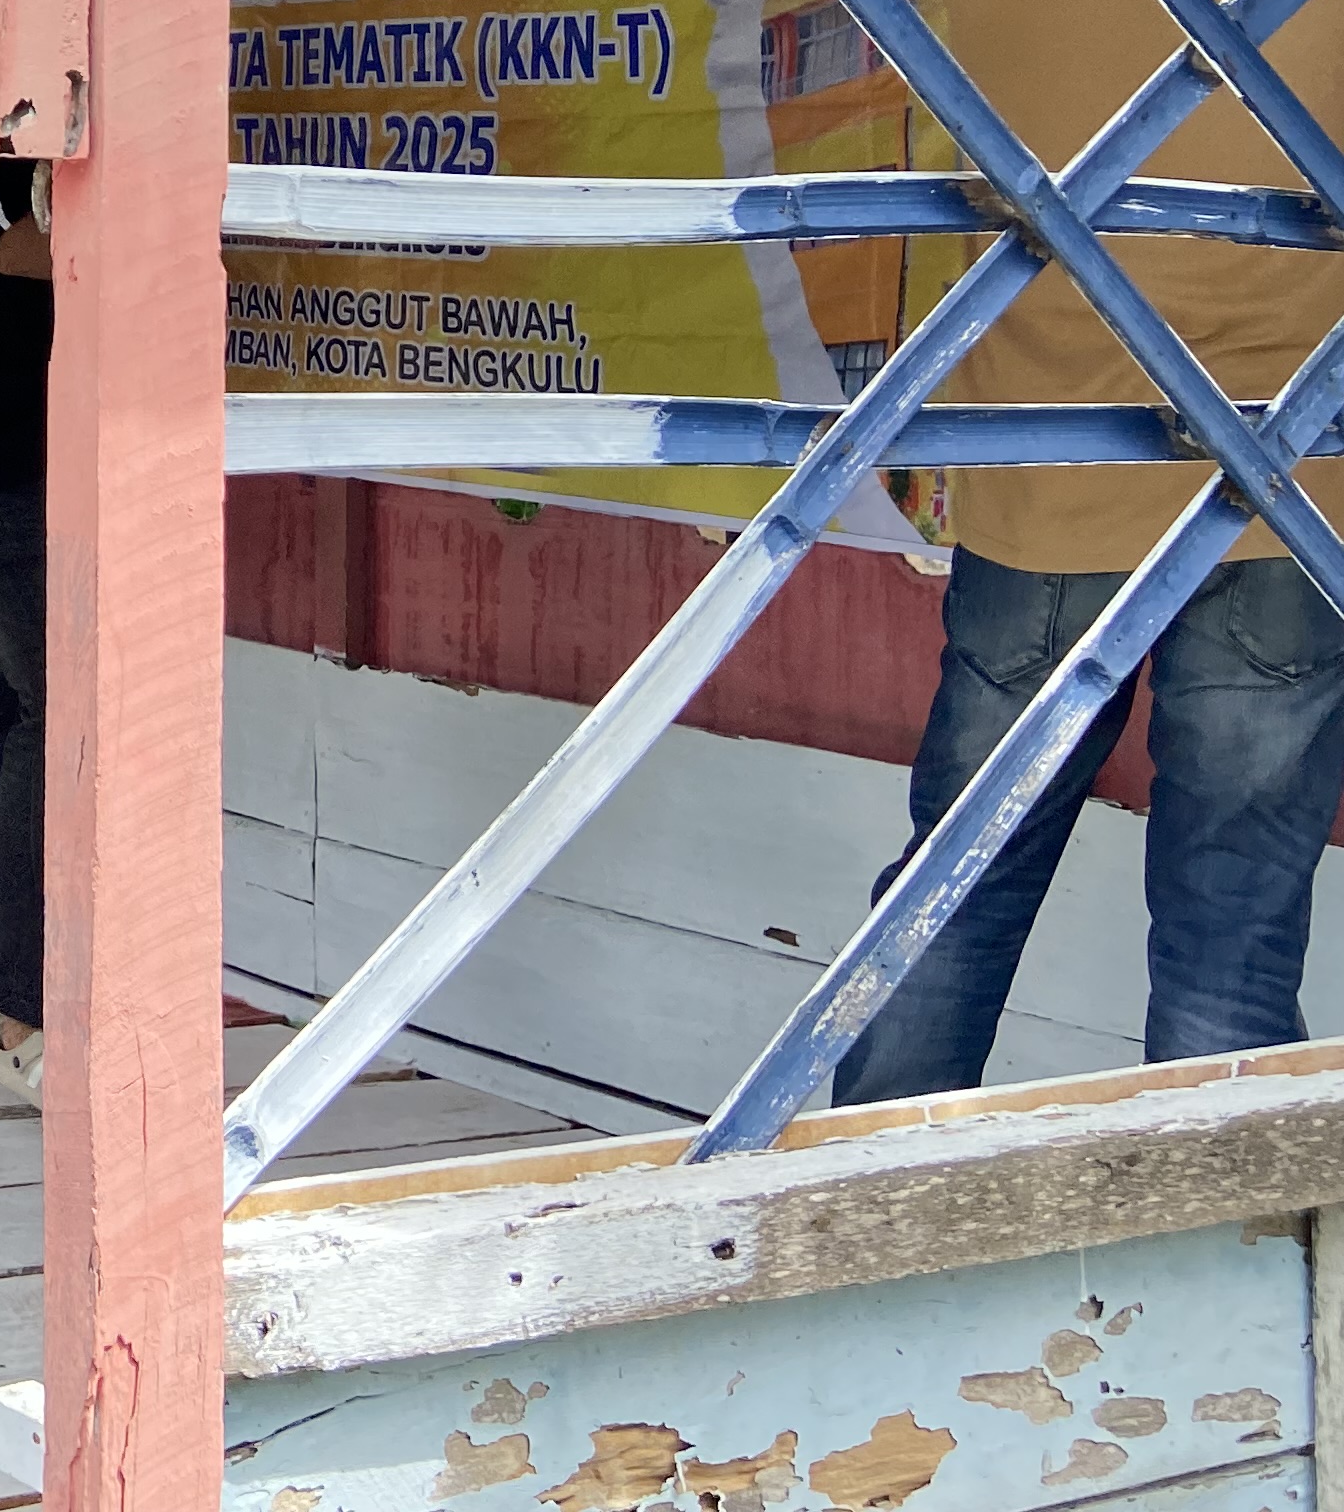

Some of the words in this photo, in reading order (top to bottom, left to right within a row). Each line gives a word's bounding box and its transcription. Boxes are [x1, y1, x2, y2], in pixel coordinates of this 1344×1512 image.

[278, 20, 464, 87] TEMATIK
[478, 8, 672, 98] (KKN-T)
[236, 116, 368, 170] TAHUN
[384, 115, 497, 176] 2025
[290, 288, 431, 332] ANGGUT
[441, 296, 587, 350] BAWAH,
[306, 335, 387, 379] KOTA
[398, 343, 601, 394] BENGKULU
